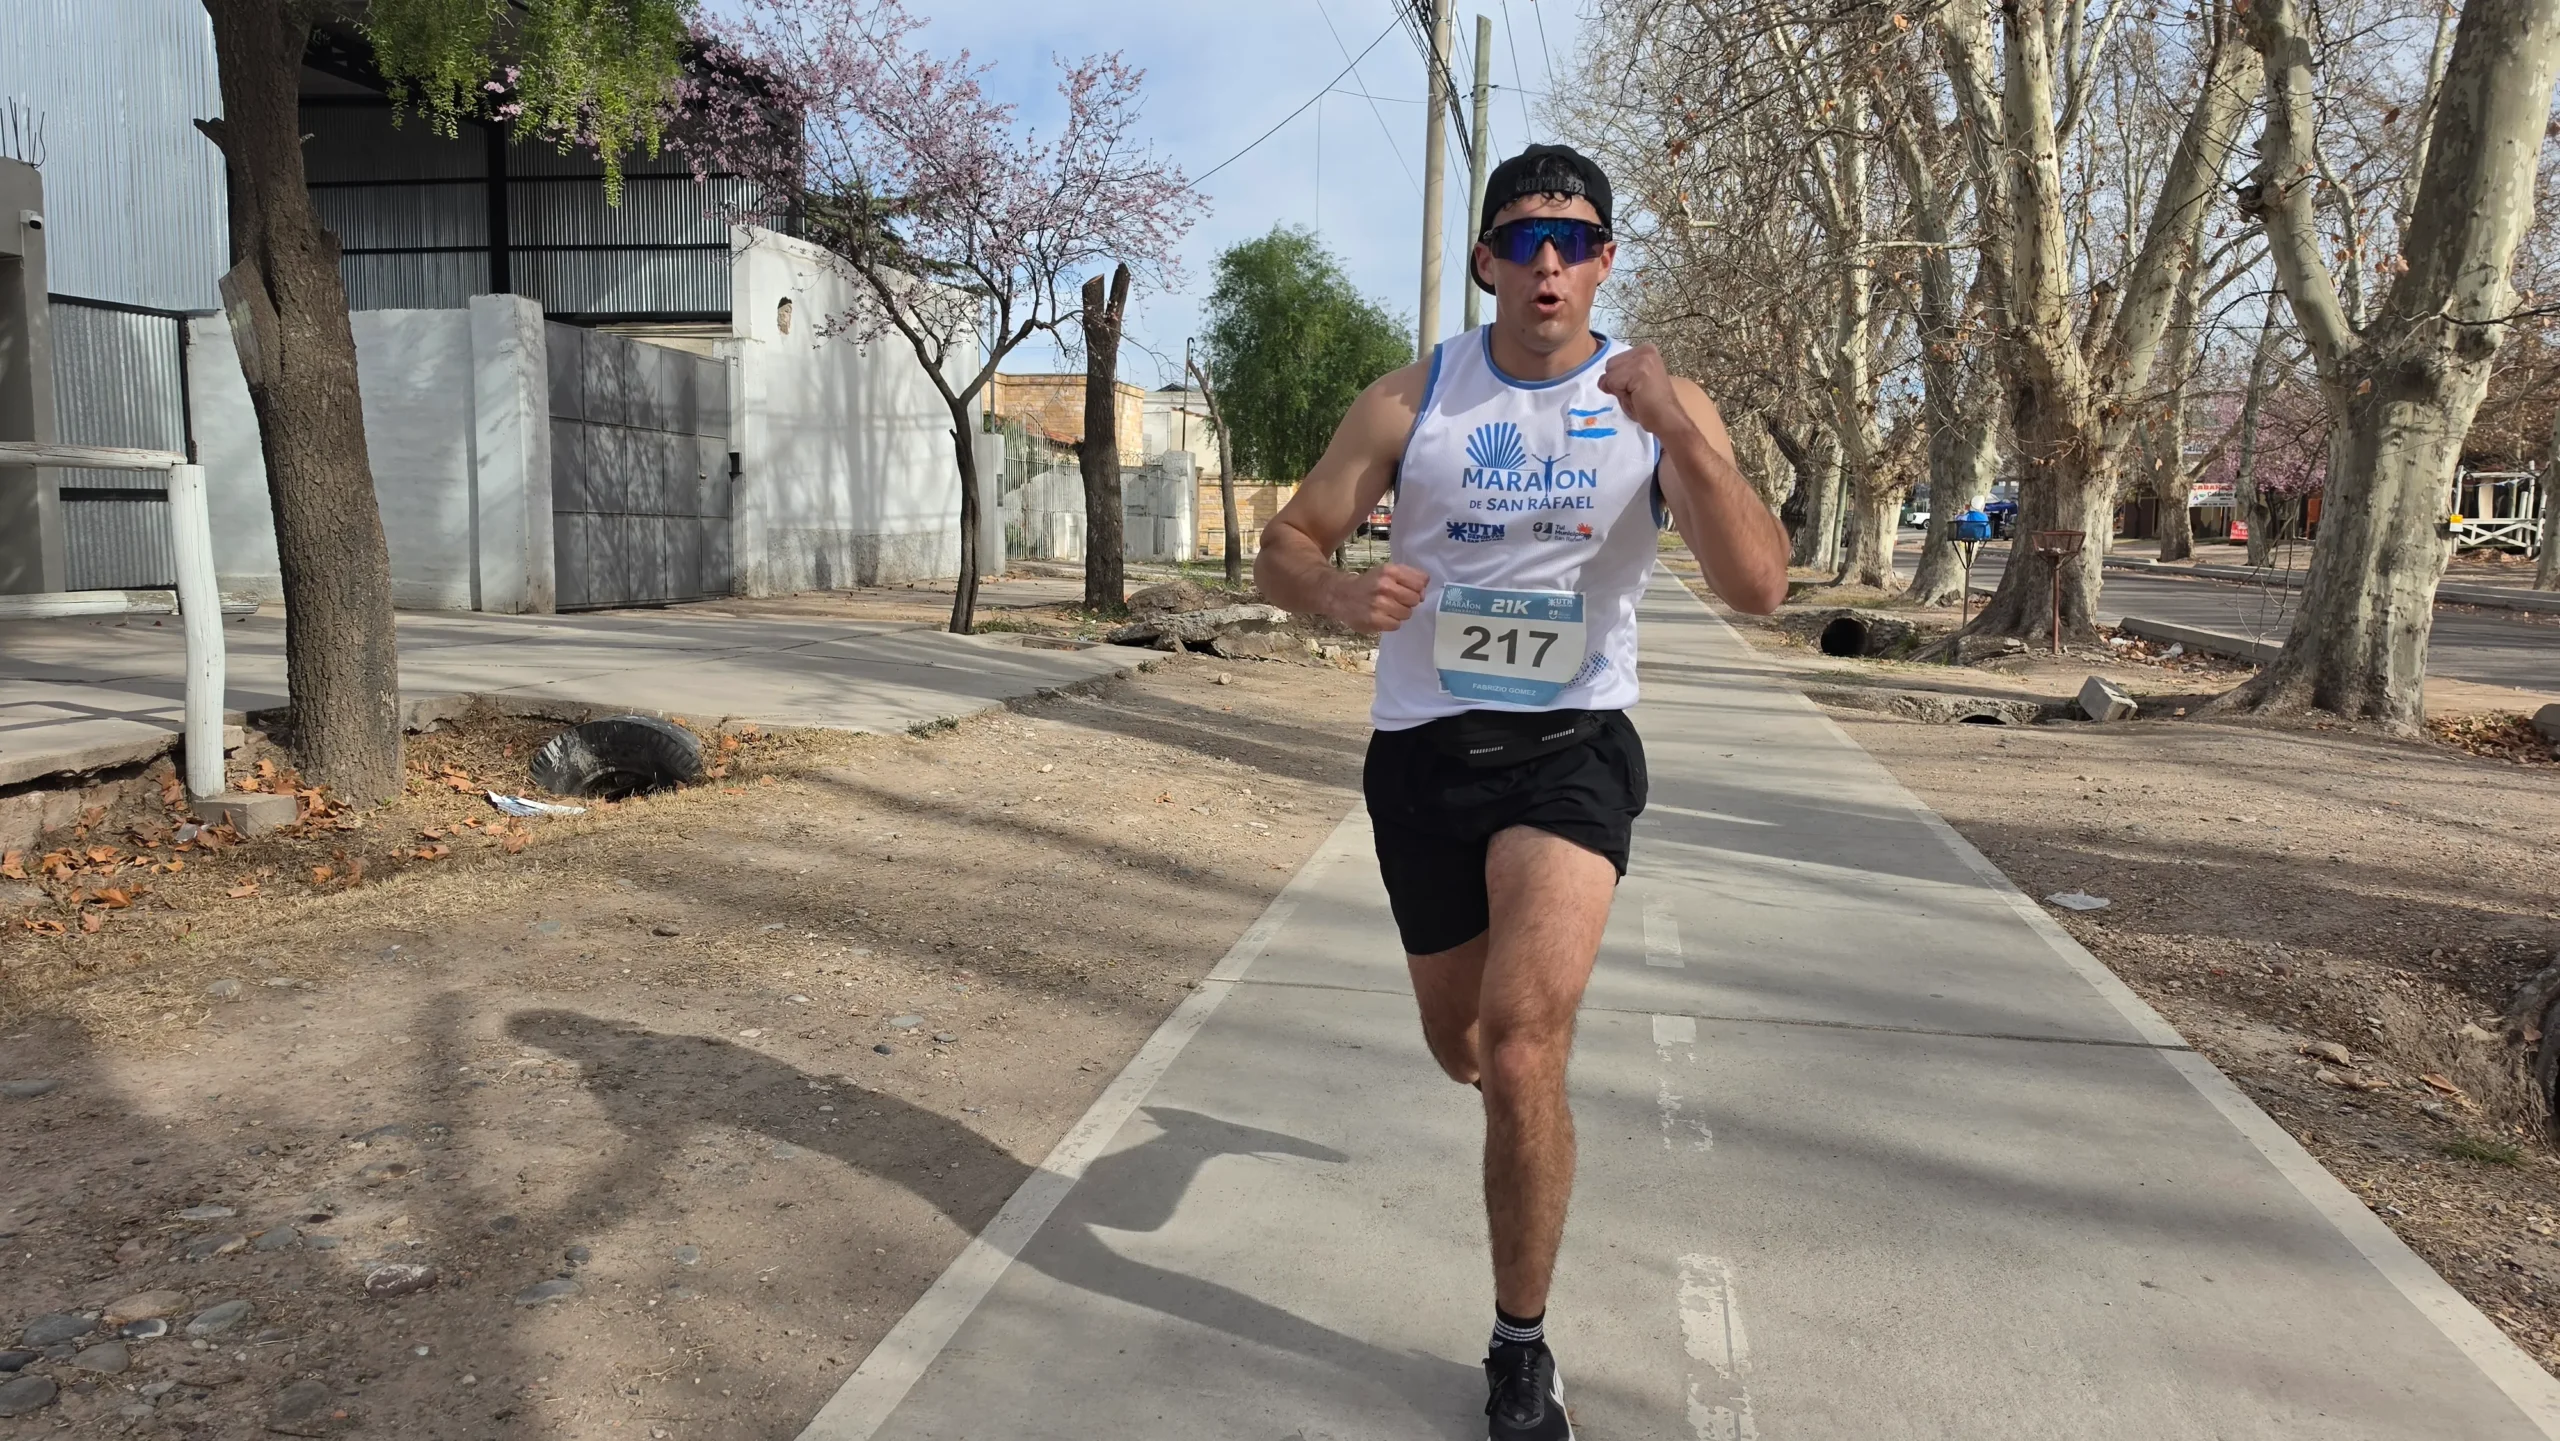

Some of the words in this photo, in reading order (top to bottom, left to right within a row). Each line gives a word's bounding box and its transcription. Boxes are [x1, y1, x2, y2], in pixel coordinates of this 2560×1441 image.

[1469, 500, 1482, 509] DE
[1486, 497, 1523, 511] SAN
[1527, 496, 1594, 511] RAFAEL
[1467, 522, 1505, 535] UTN
[1491, 598, 1532, 615] 21K
[1460, 626, 1559, 668] 217
[1472, 683, 1507, 693] FABRIZIO
[1508, 687, 1537, 697] GOMEZ
